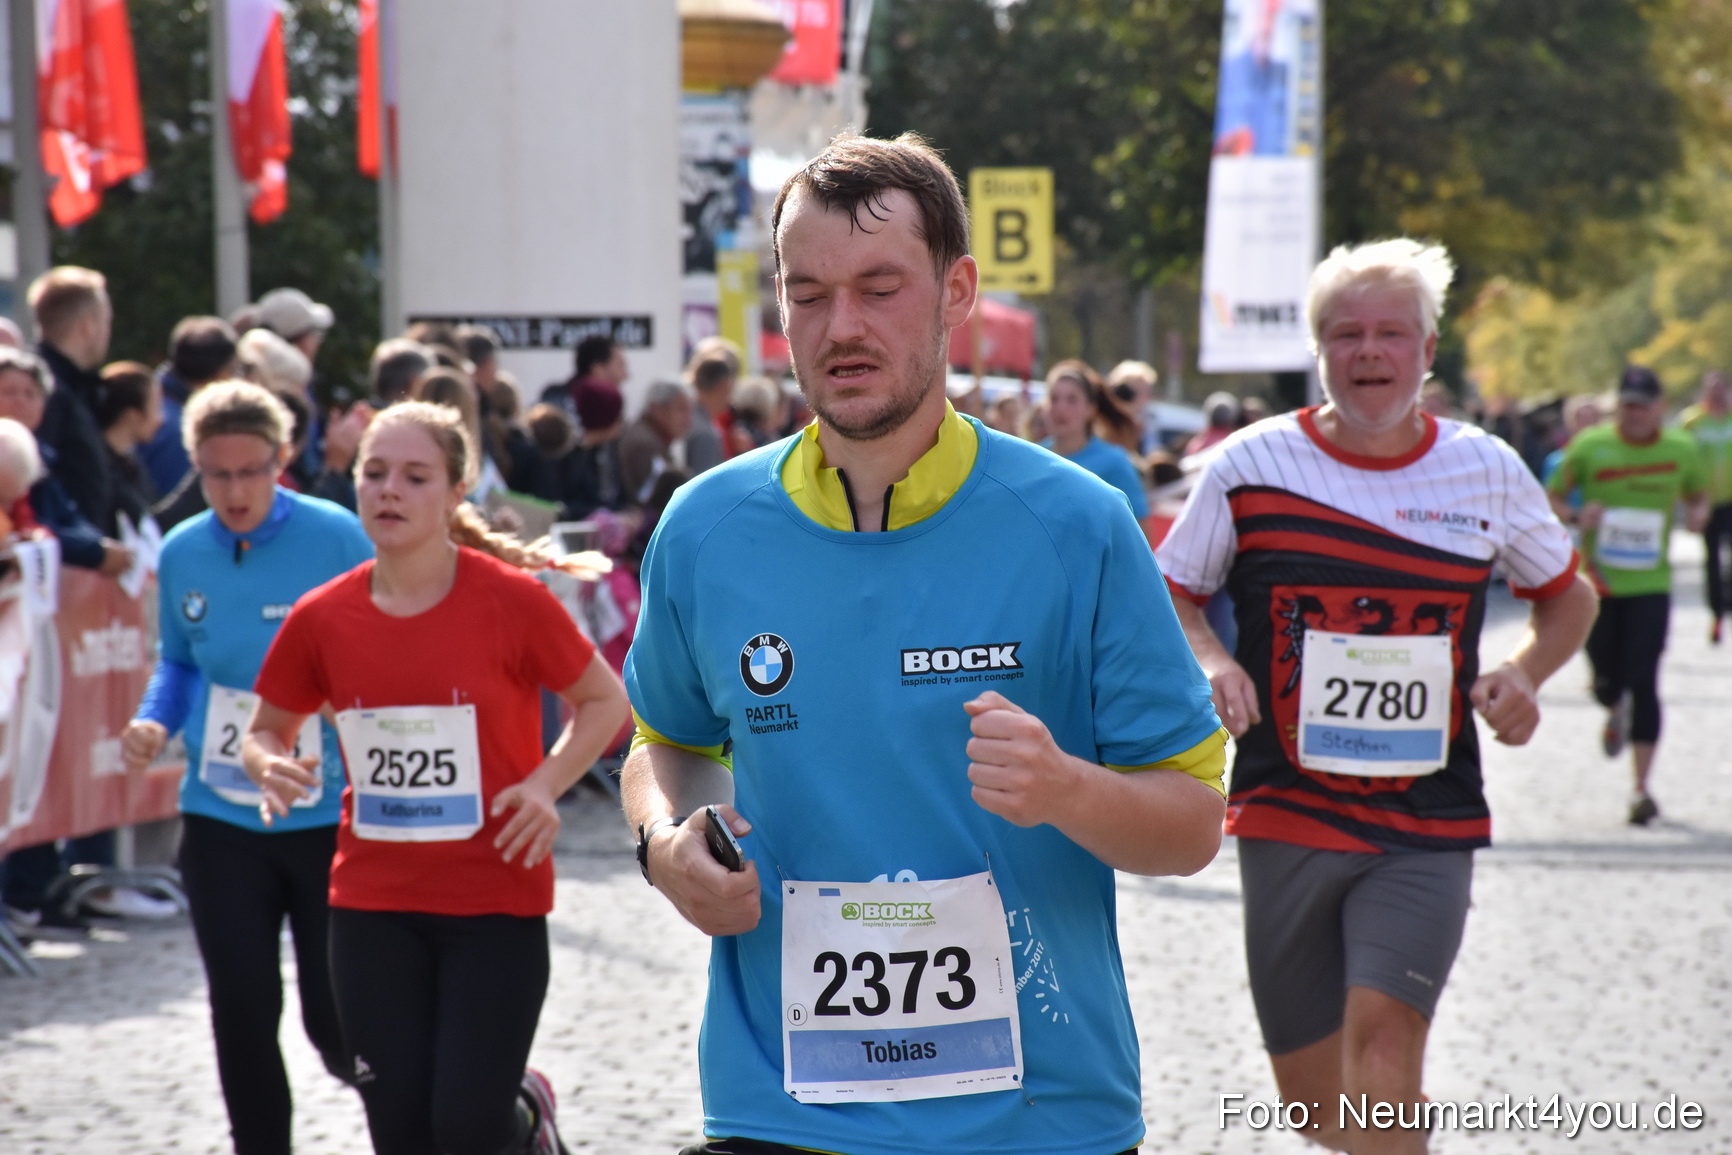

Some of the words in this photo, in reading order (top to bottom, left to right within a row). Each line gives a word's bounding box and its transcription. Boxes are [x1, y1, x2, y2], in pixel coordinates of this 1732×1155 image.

[994, 209, 1030, 262] B
[1395, 508, 1477, 527] NEUMARKT
[743, 635, 788, 657] BMW
[902, 643, 1022, 675] BOCK
[901, 677, 938, 687] inspired
[940, 676, 952, 685] by
[954, 674, 982, 684] smart
[984, 671, 1024, 681] concepts
[1324, 678, 1427, 721] 2780
[745, 703, 798, 722] PARTL
[749, 719, 799, 735] Neumarkt
[368, 748, 457, 788] 2525
[381, 803, 443, 818] Katharina
[863, 902, 934, 920] BOCK
[909, 920, 937, 928] concepts
[1030, 941, 1044, 968] 2017
[813, 946, 976, 1017] 2373
[793, 1009, 801, 1021] D
[862, 1040, 937, 1063] Tobias
